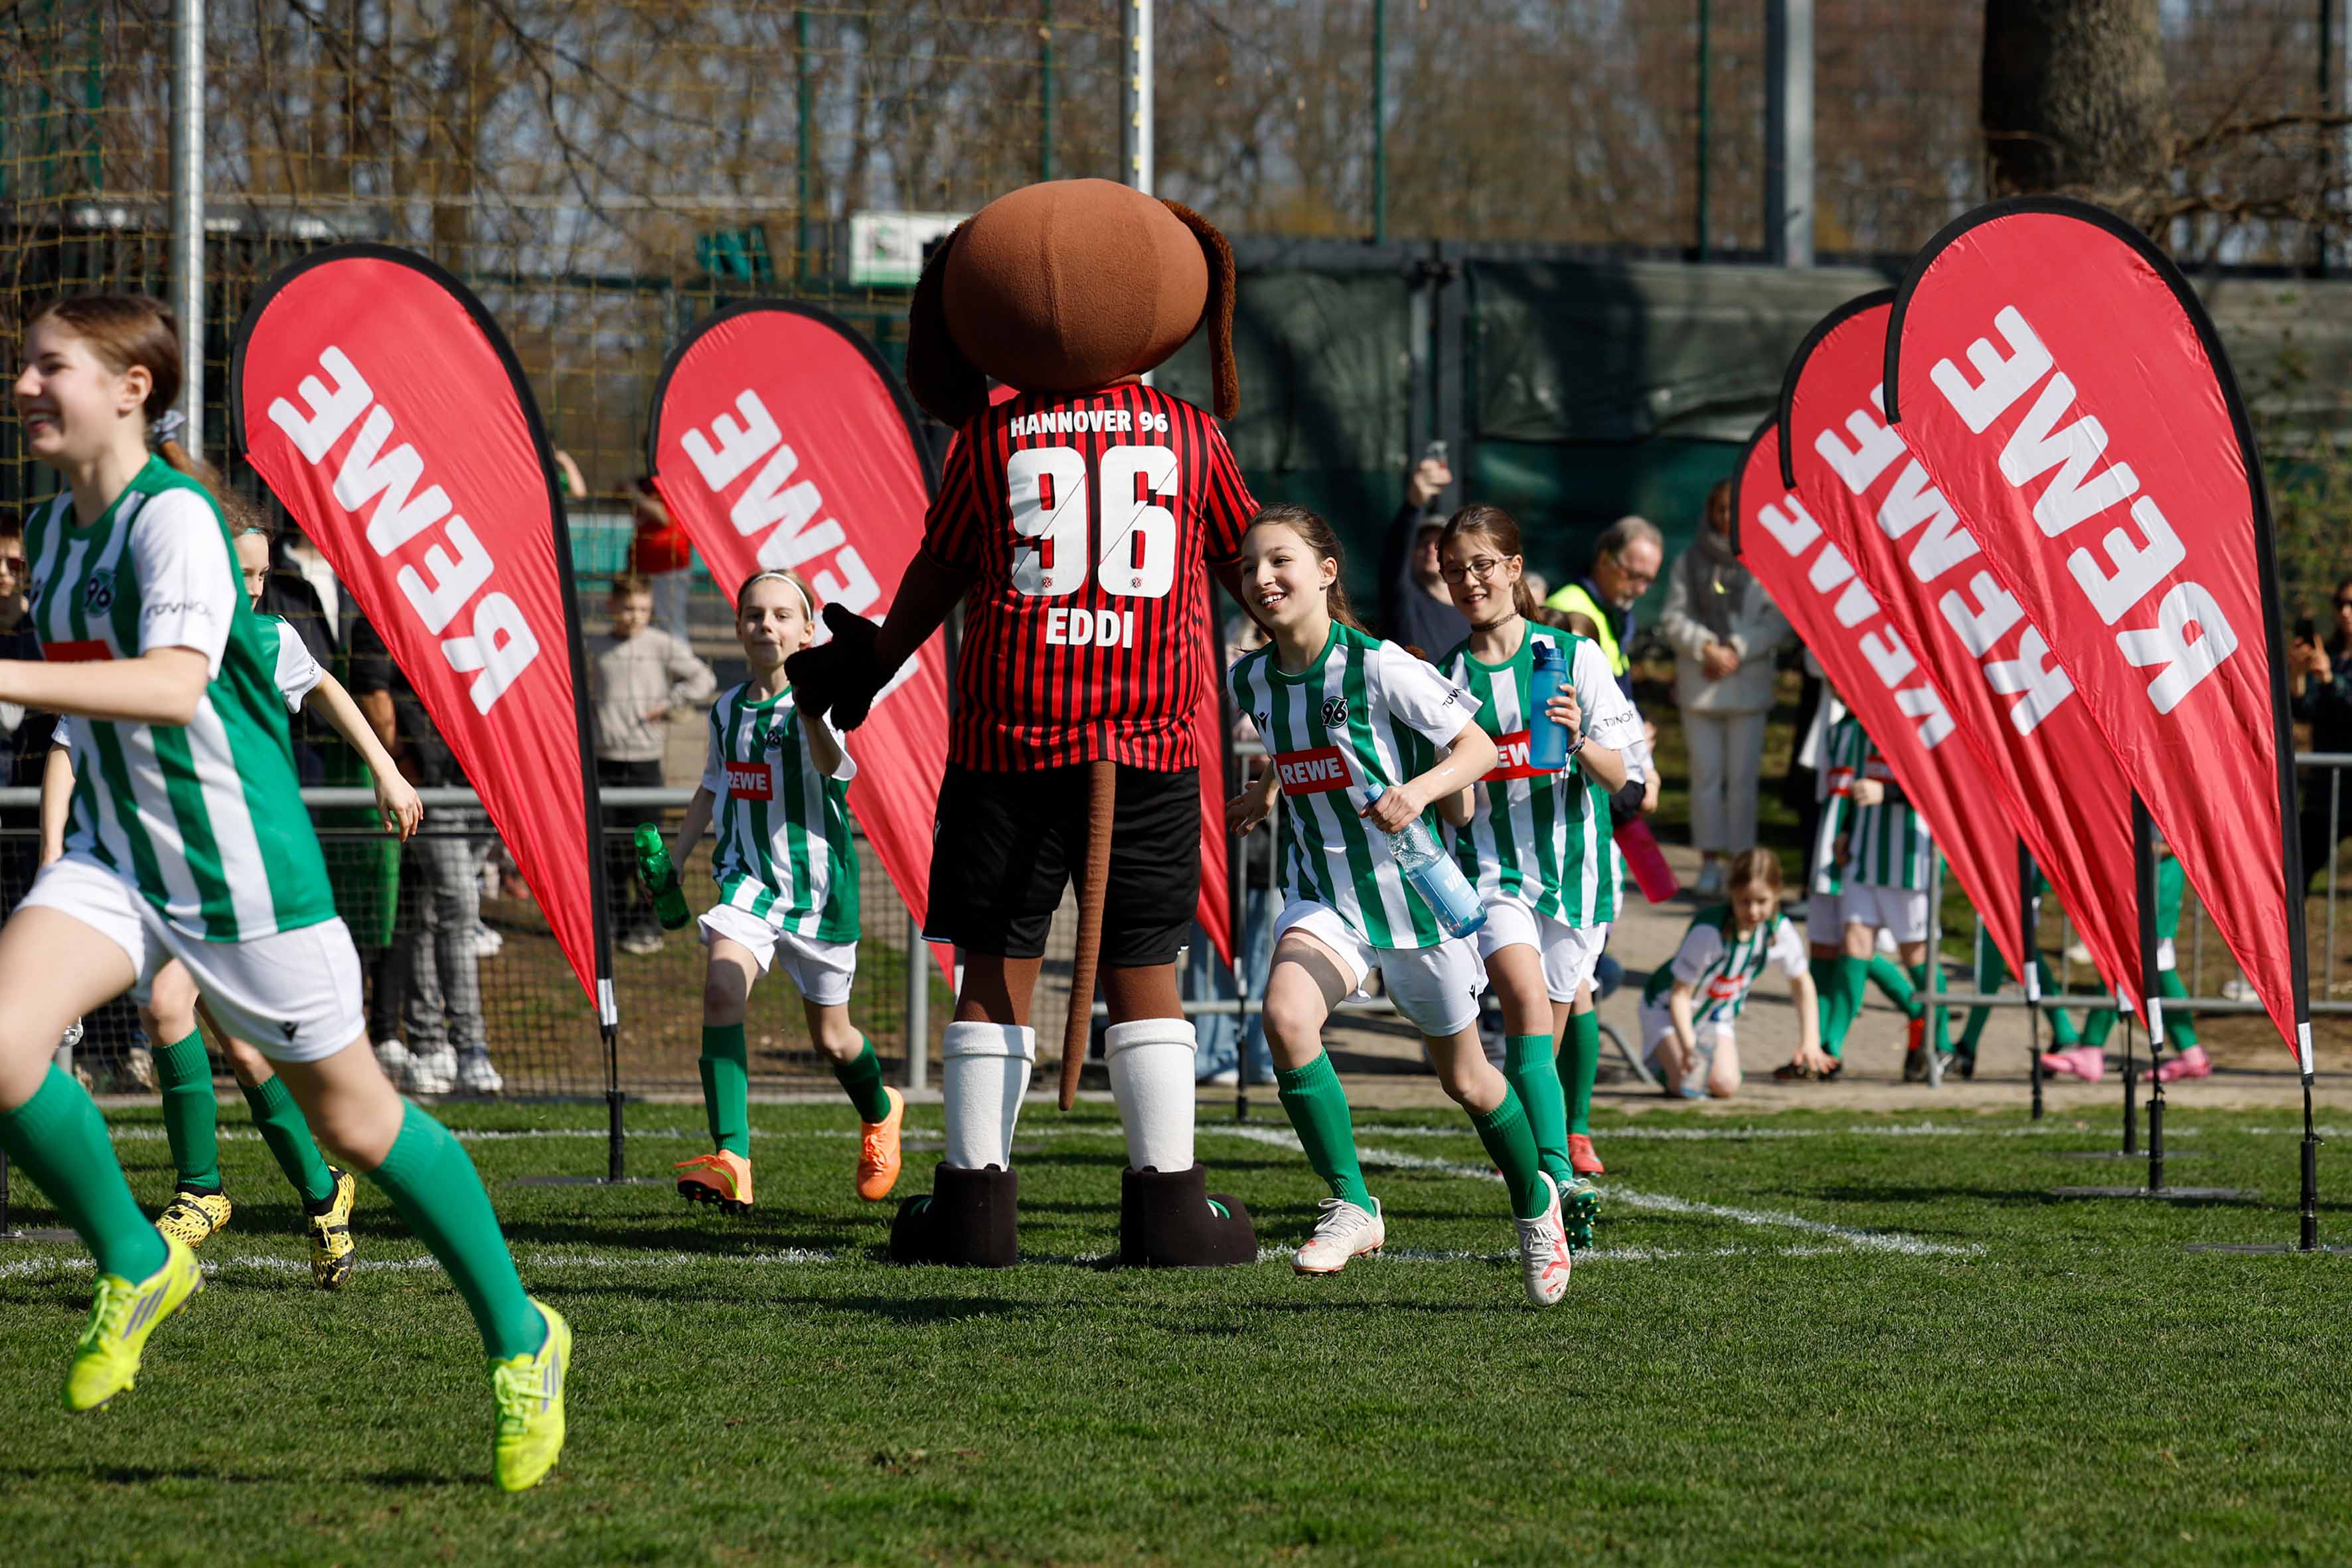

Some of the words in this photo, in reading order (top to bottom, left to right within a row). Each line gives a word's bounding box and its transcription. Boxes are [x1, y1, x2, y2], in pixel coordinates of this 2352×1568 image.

[1010, 410, 1132, 437] HANNOVER
[1139, 412, 1169, 433] 96
[1007, 445, 1178, 598] 96
[1046, 607, 1134, 648] EDDI
[1322, 698, 1349, 726] 96
[1497, 742, 1530, 768] EW
[1280, 757, 1344, 784] REWE
